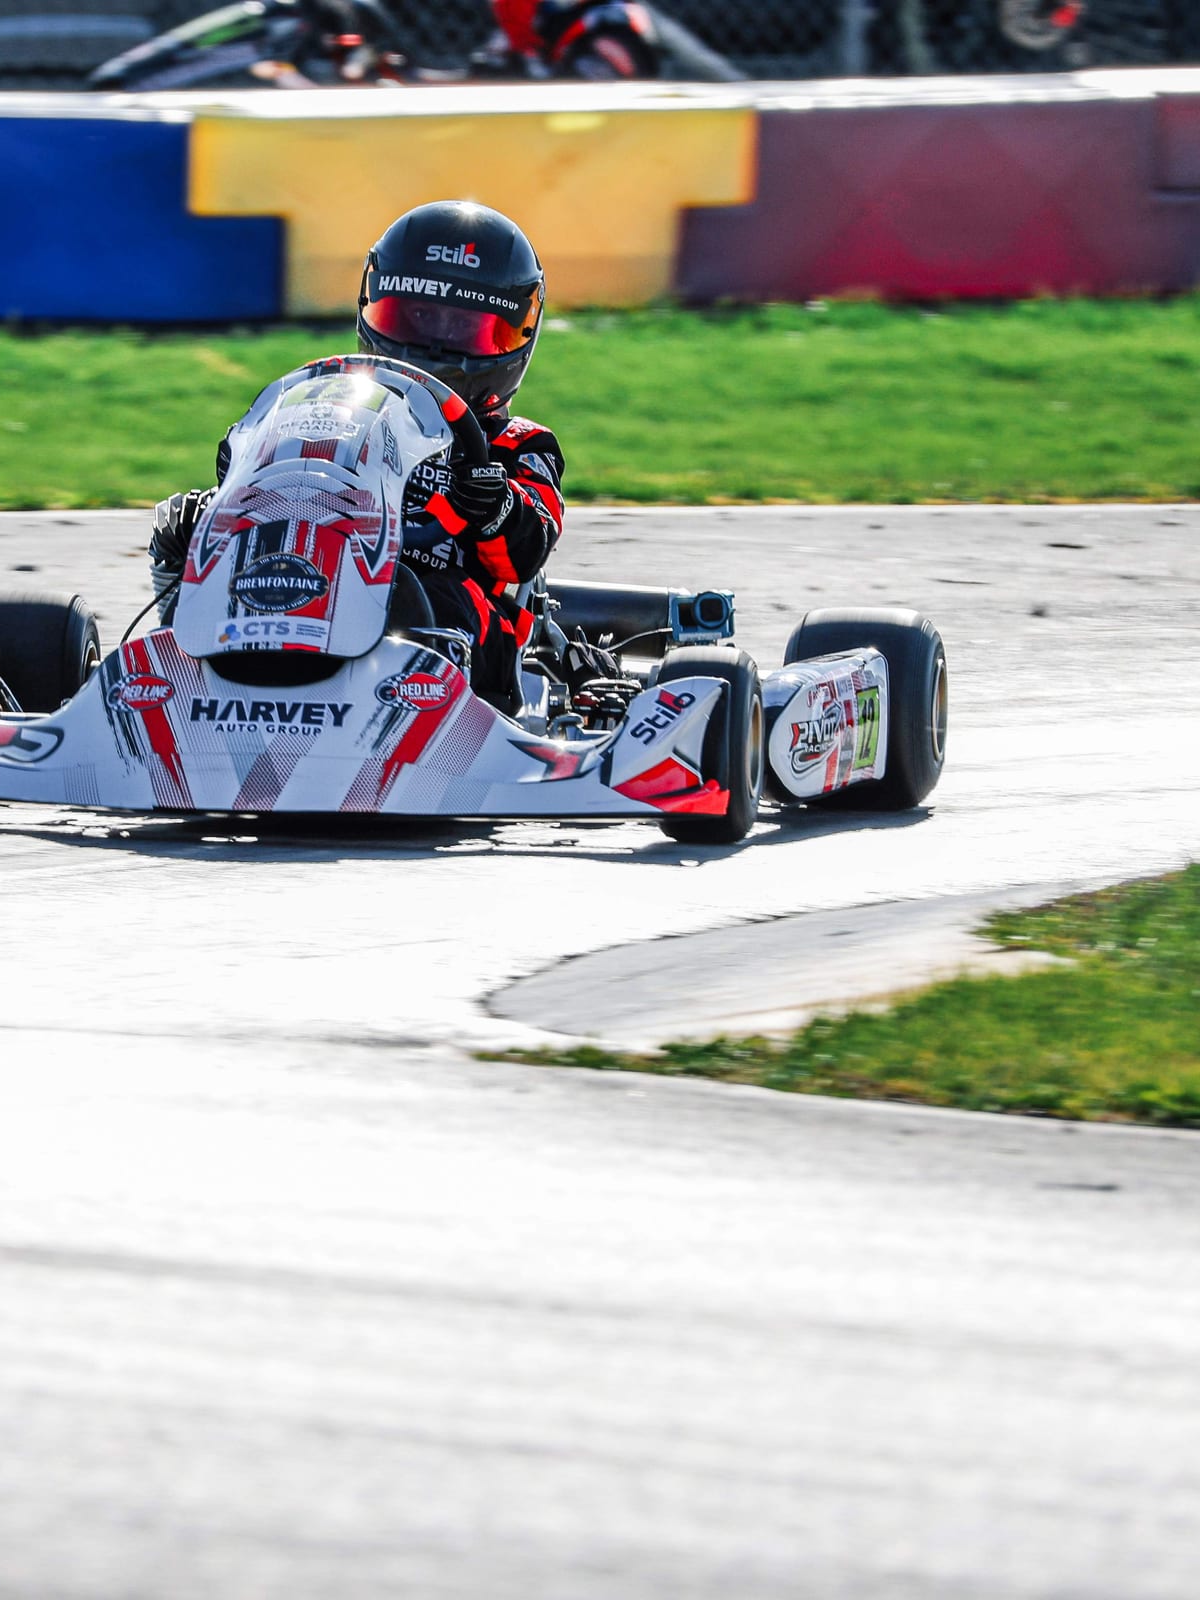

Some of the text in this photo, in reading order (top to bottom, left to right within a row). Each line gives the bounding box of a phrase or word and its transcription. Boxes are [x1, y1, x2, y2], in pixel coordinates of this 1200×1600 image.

[425, 242, 481, 269] Stilo
[378, 276, 520, 312] HARVEY AUTO GROUP
[235, 576, 322, 592] BREWFONTAINE
[243, 621, 291, 636] CTS
[400, 683, 447, 697] RED LINE
[190, 697, 354, 728] HARVEY
[630, 689, 697, 745] Stilo
[215, 723, 322, 737] AUTO GROUP
